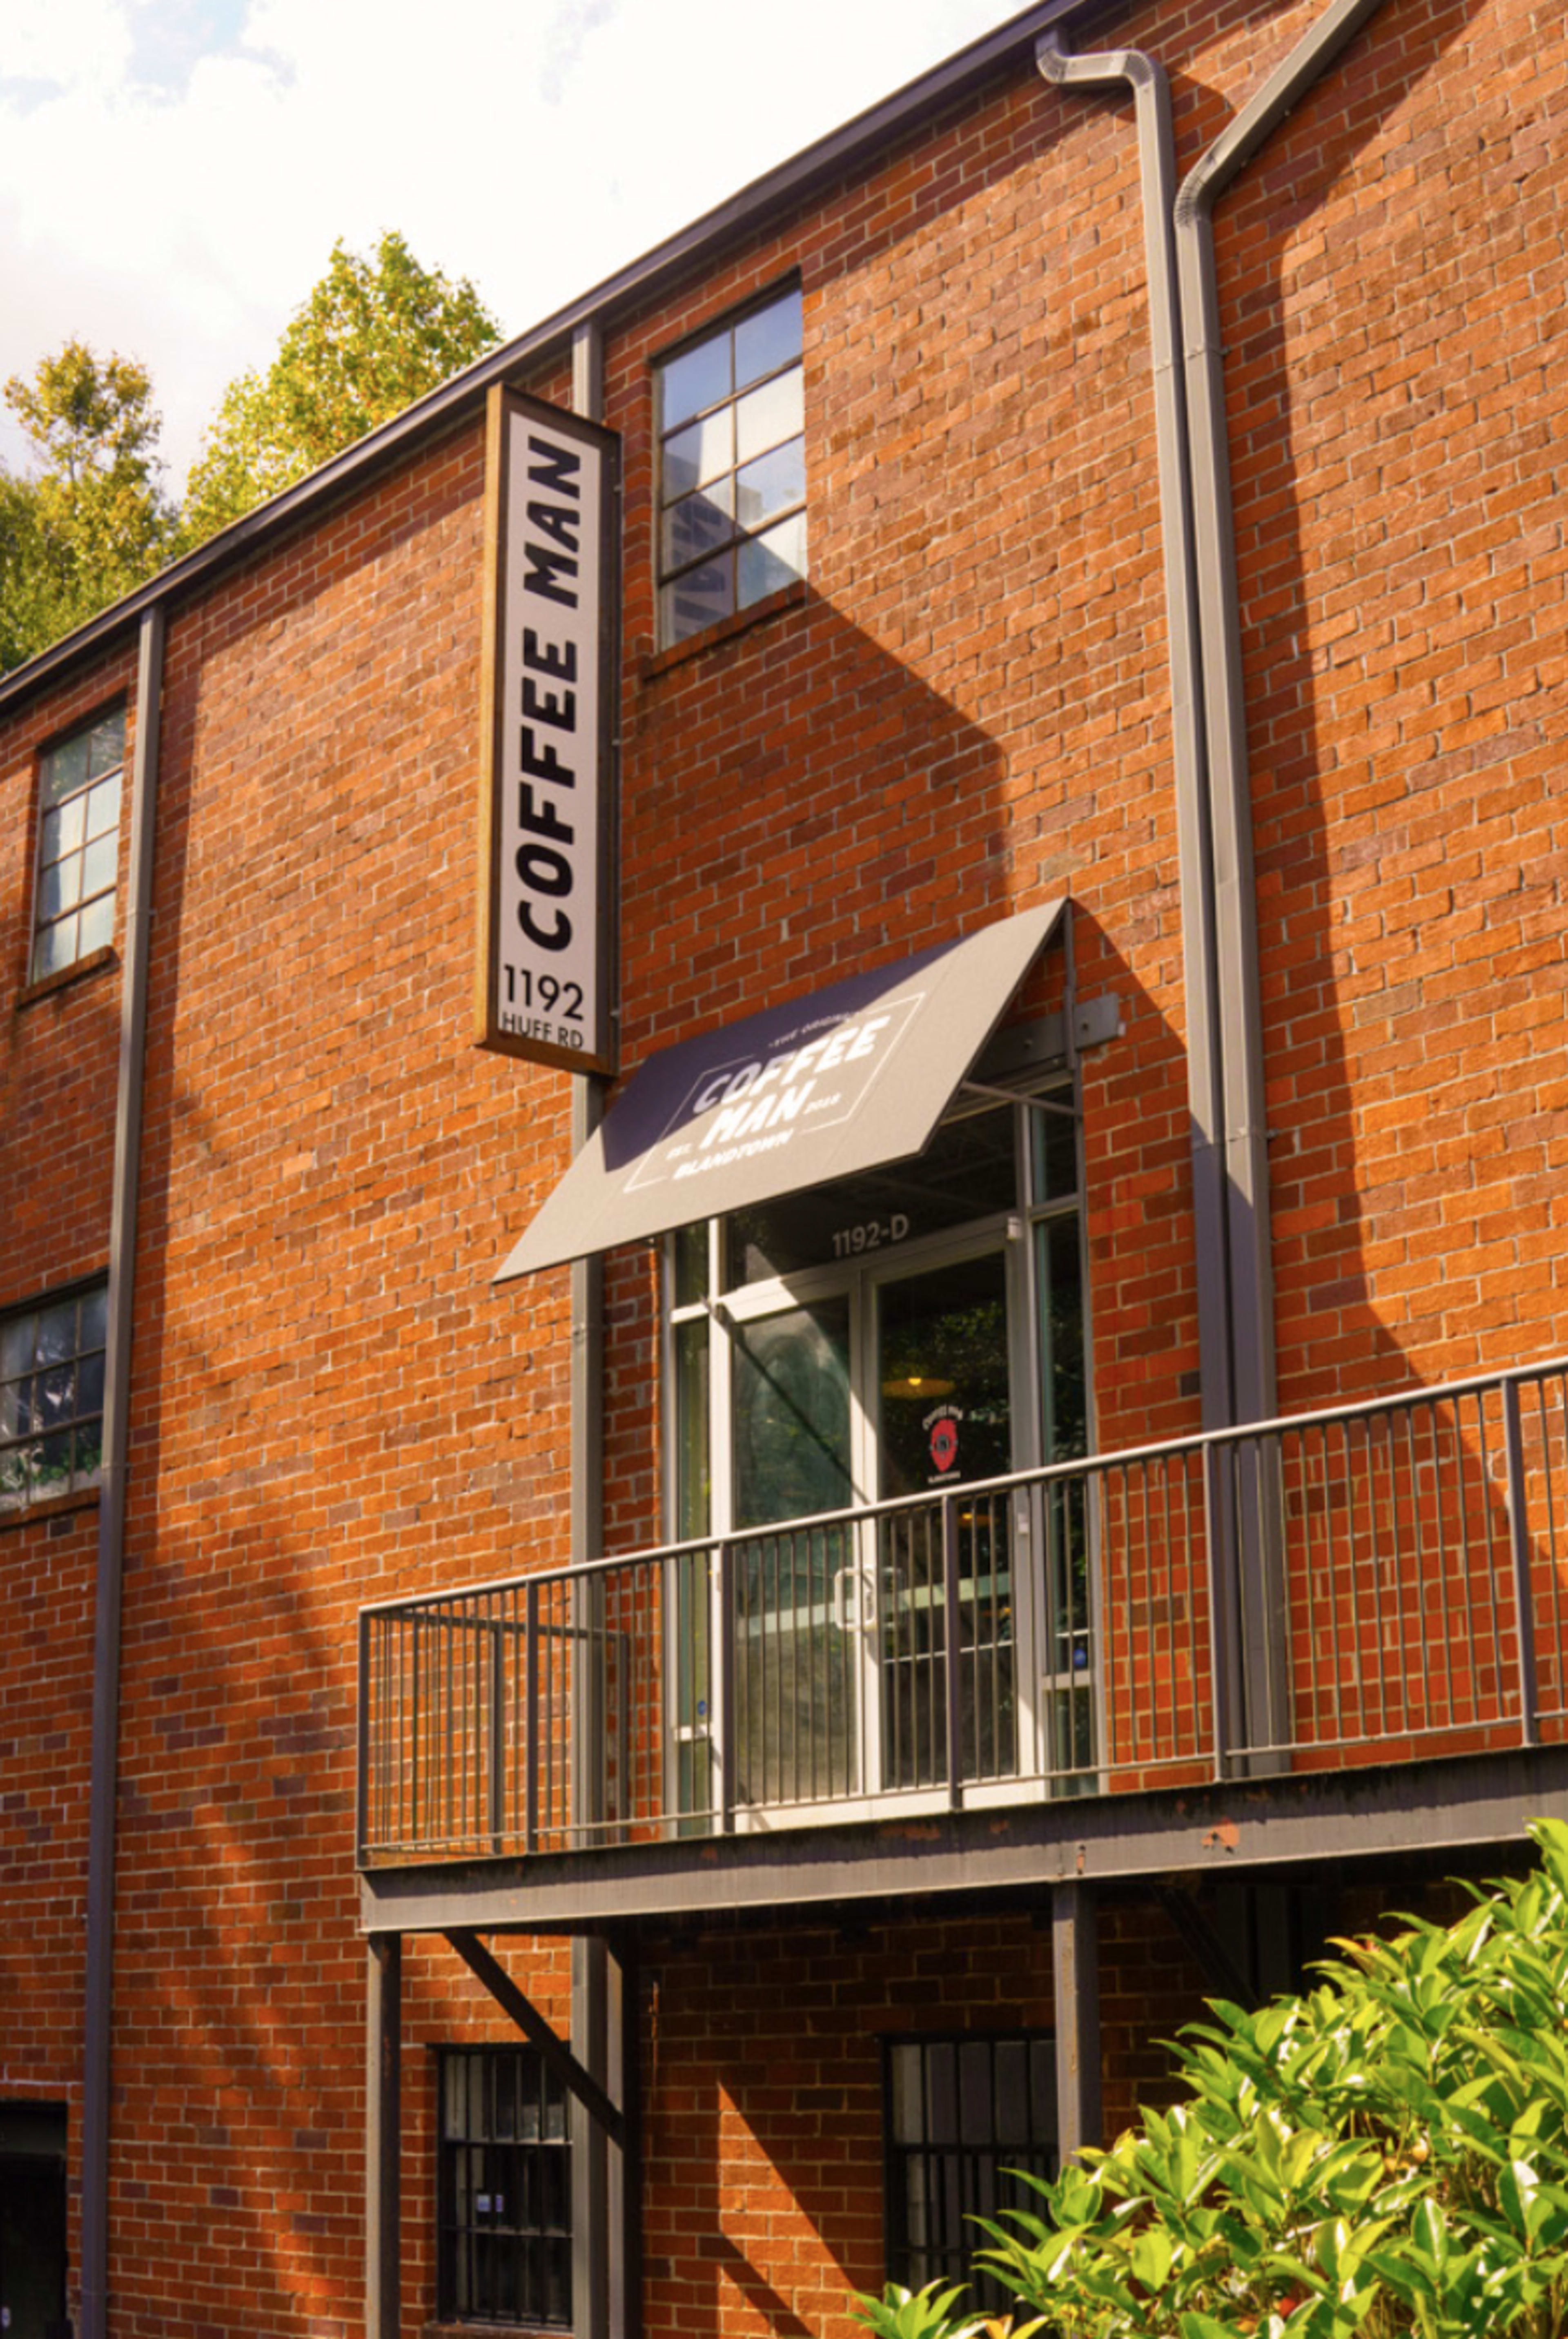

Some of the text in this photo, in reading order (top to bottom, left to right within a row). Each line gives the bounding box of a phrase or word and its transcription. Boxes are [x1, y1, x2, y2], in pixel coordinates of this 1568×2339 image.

[515, 435, 580, 952] COFFEE MAN
[504, 962, 584, 1021] 1192
[502, 1011, 584, 1049] HUFF RD
[692, 1016, 891, 1114] COFFEE
[699, 1079, 817, 1150] MAN
[832, 1213, 909, 1257] 1192-D
